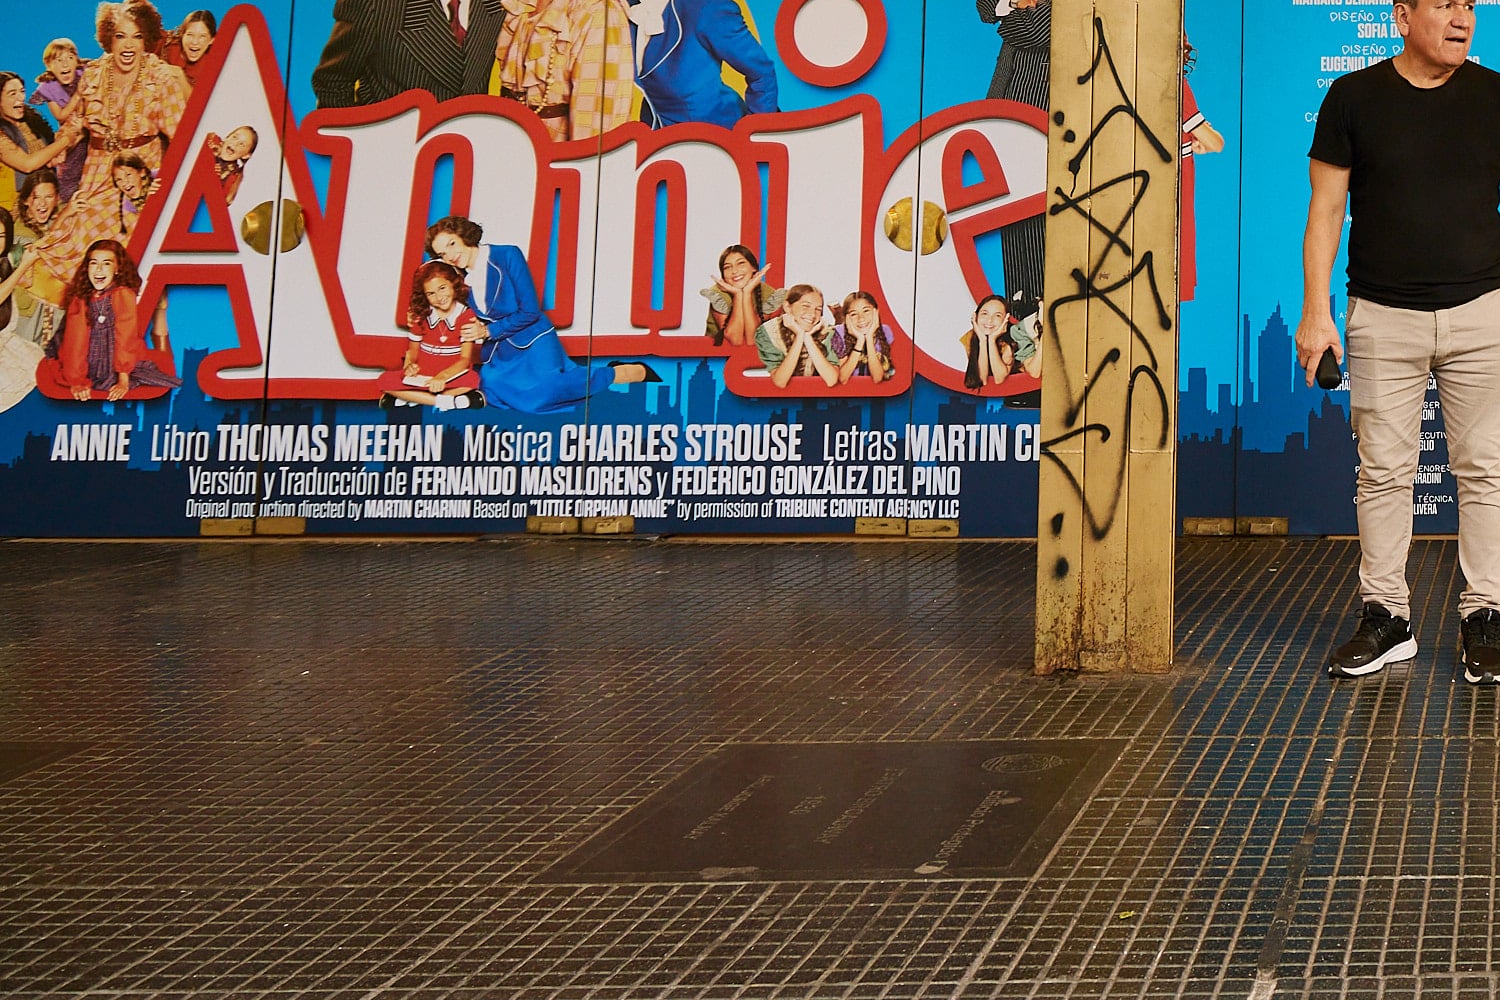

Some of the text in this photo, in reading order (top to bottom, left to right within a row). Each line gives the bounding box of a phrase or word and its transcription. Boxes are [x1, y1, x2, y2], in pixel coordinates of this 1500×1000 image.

[1329, 10, 1375, 23] DISEÑO
[1357, 23, 1388, 39] SOFIA
[1341, 43, 1387, 56] DISEÑO
[50, 424, 130, 462] ANNIE
[150, 424, 211, 462] Libro
[217, 424, 330, 462] THOMAS
[334, 424, 444, 462] MEEHAN
[463, 422, 552, 462] Música
[560, 423, 679, 462] CHARLES
[684, 423, 802, 462] STROUSE
[823, 423, 897, 462] Letras
[905, 423, 1008, 462] MARTIN
[188, 460, 961, 496] Versión Traducción FERNANDO MASLLORENS FEDERICO GONZÁLEZ DEL PINO
[1417, 493, 1454, 503] TÉCNICA
[185, 499, 961, 522] Original directed MARTIN CHARNIN Based by permission TRIBUNE CONTENT AGENCY LLC
